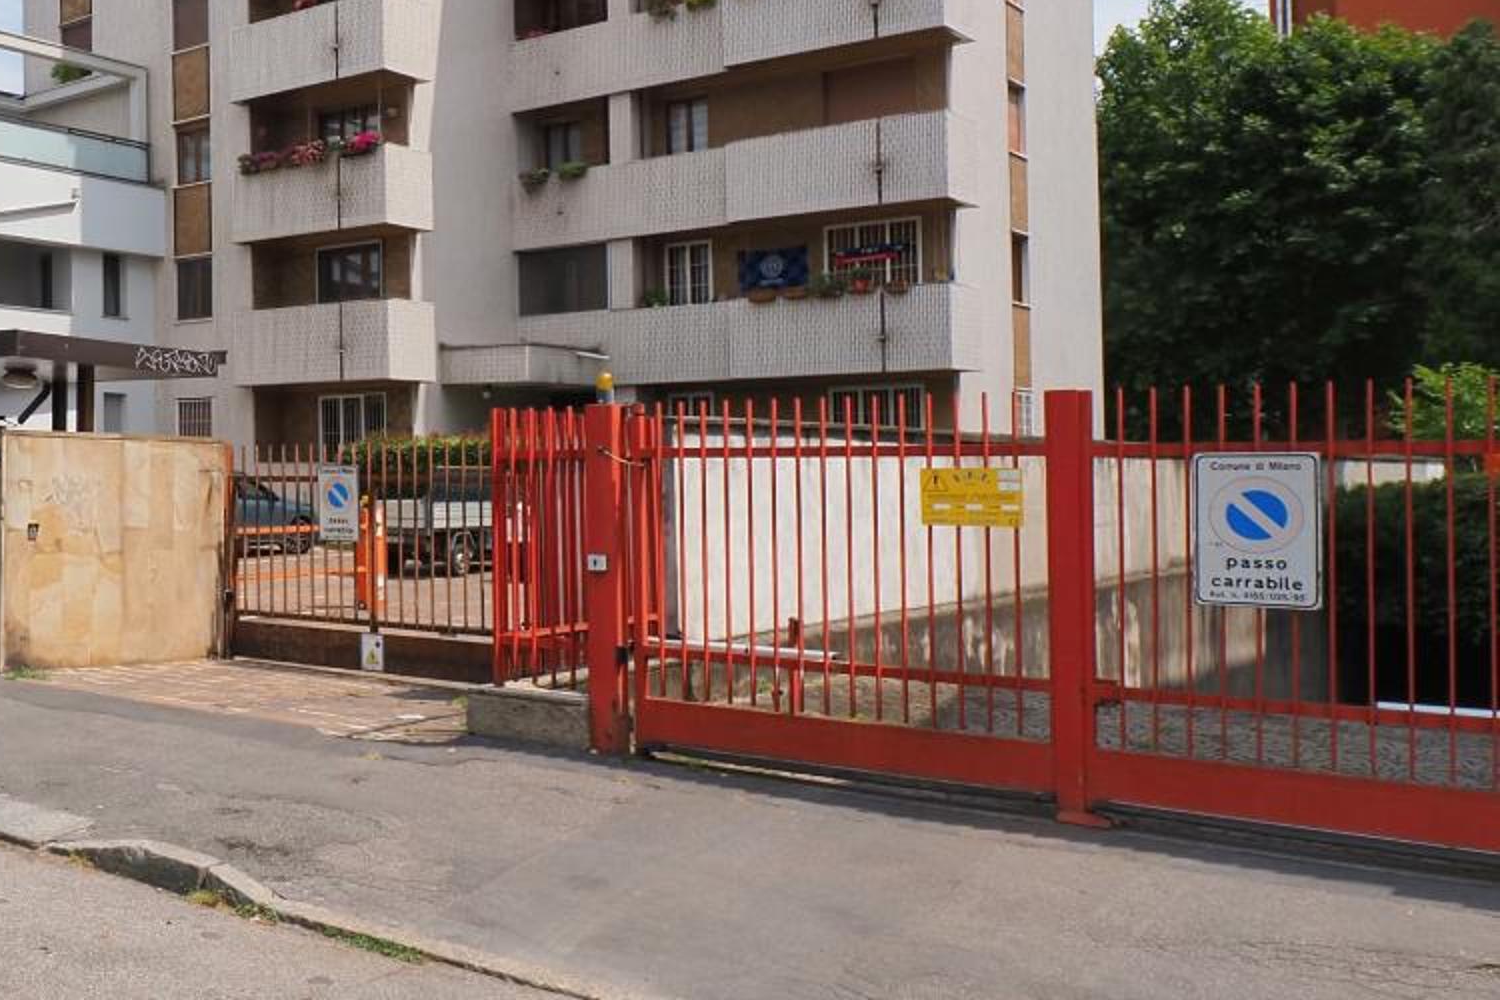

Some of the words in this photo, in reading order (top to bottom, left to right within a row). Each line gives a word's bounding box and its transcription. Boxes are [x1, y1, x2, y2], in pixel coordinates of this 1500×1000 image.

[1210, 462, 1250, 470] Comune
[1255, 462, 1264, 470] di
[1269, 462, 1301, 470] Milano
[1226, 557, 1287, 570] passo
[1211, 577, 1303, 590] carrabile
